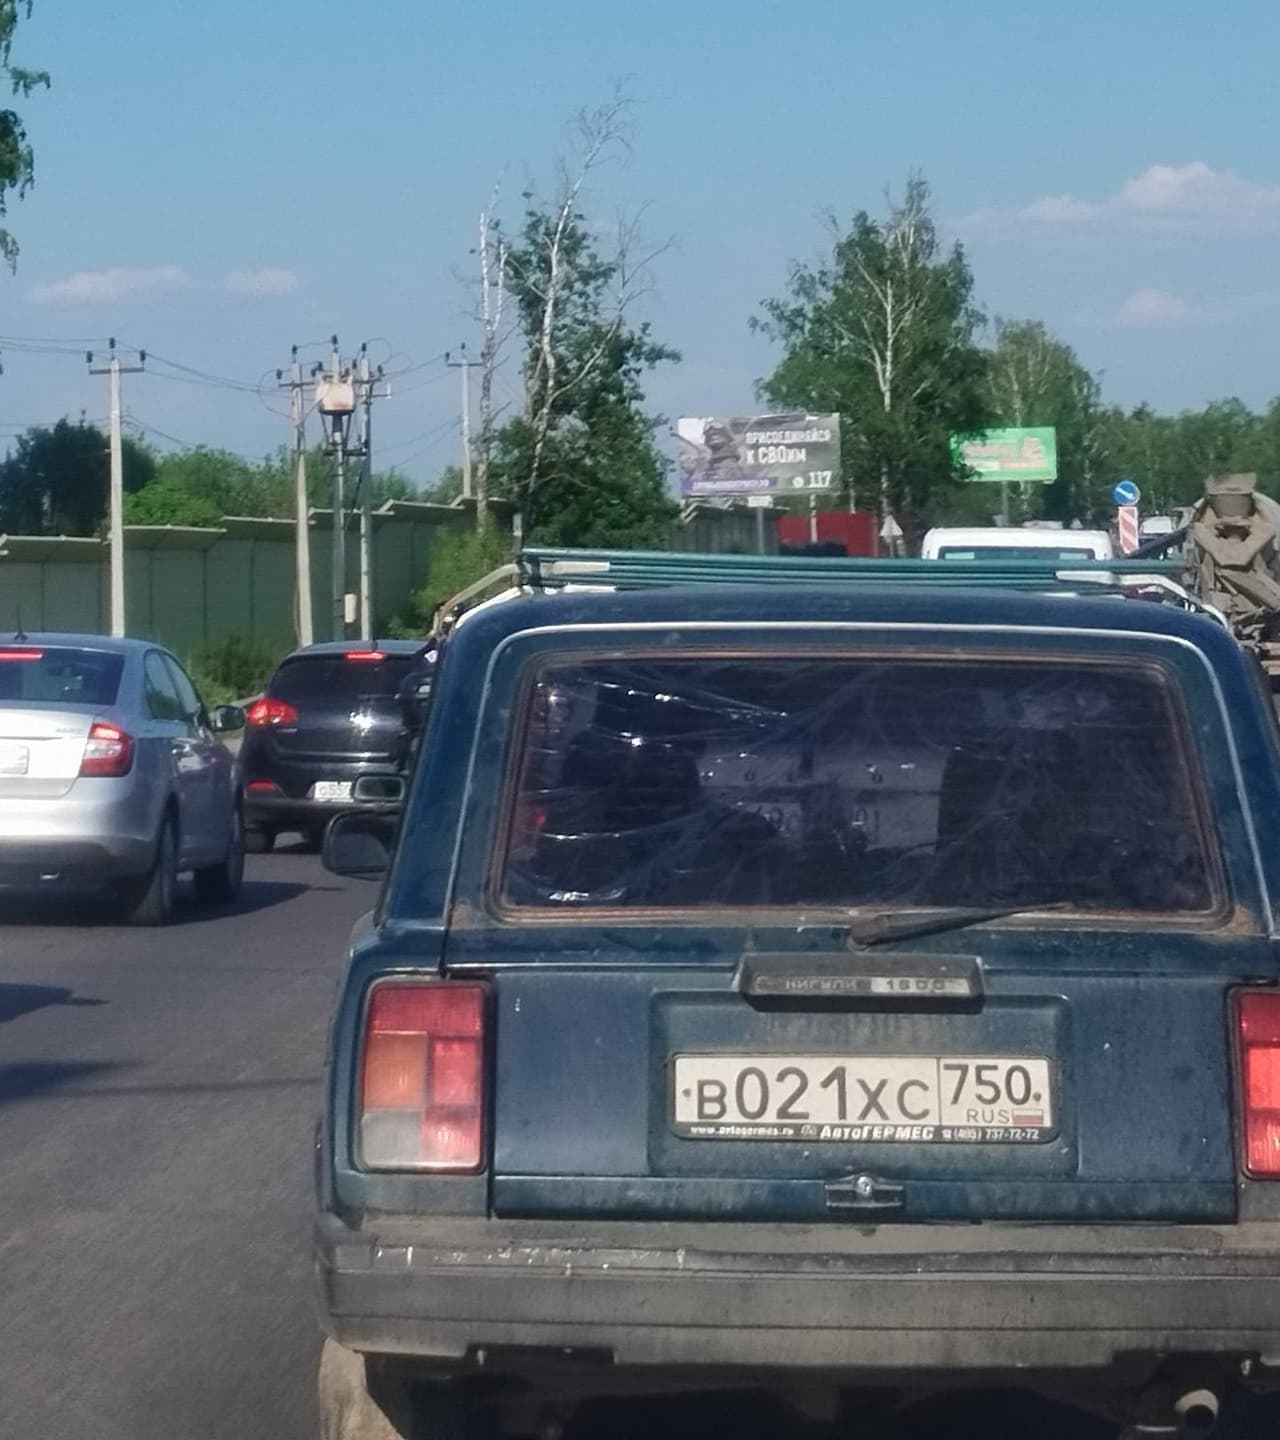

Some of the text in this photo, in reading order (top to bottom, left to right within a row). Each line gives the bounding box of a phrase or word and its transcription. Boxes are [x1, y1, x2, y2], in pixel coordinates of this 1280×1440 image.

[745, 428, 832, 445] ПРИСОЕДИНЯЙСЯ
[808, 470, 832, 488] 117
[696, 1063, 1033, 1121] В021ХС 750
[966, 1109, 1009, 1124] RUS
[820, 1125, 934, 1140] АвтоГЕРМЕС
